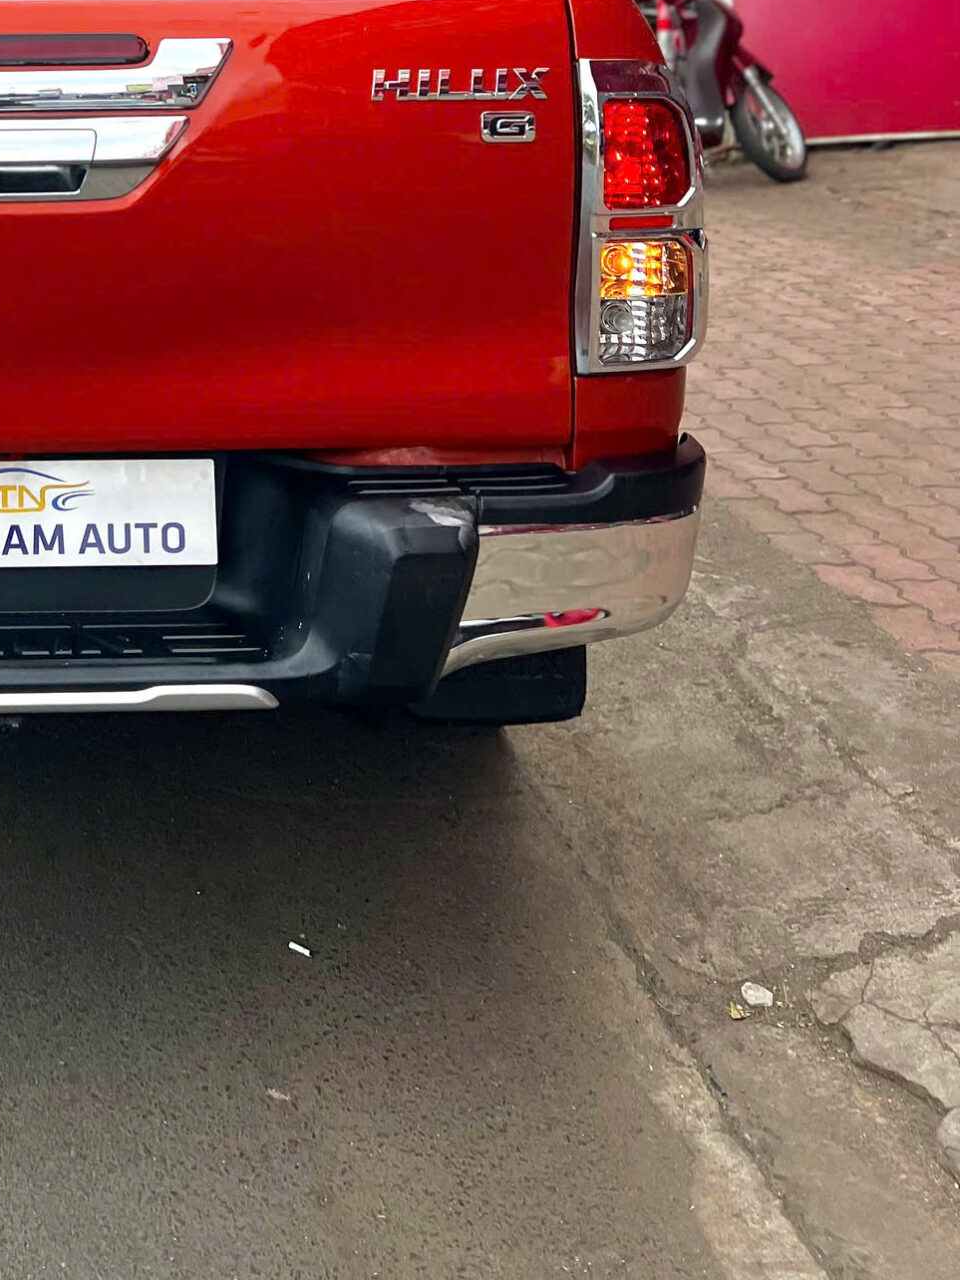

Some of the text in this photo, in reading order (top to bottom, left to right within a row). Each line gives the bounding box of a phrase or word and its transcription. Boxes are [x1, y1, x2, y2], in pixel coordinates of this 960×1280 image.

[370, 67, 550, 101] HILUX
[486, 114, 534, 138] G
[78, 522, 186, 554] AUTO
